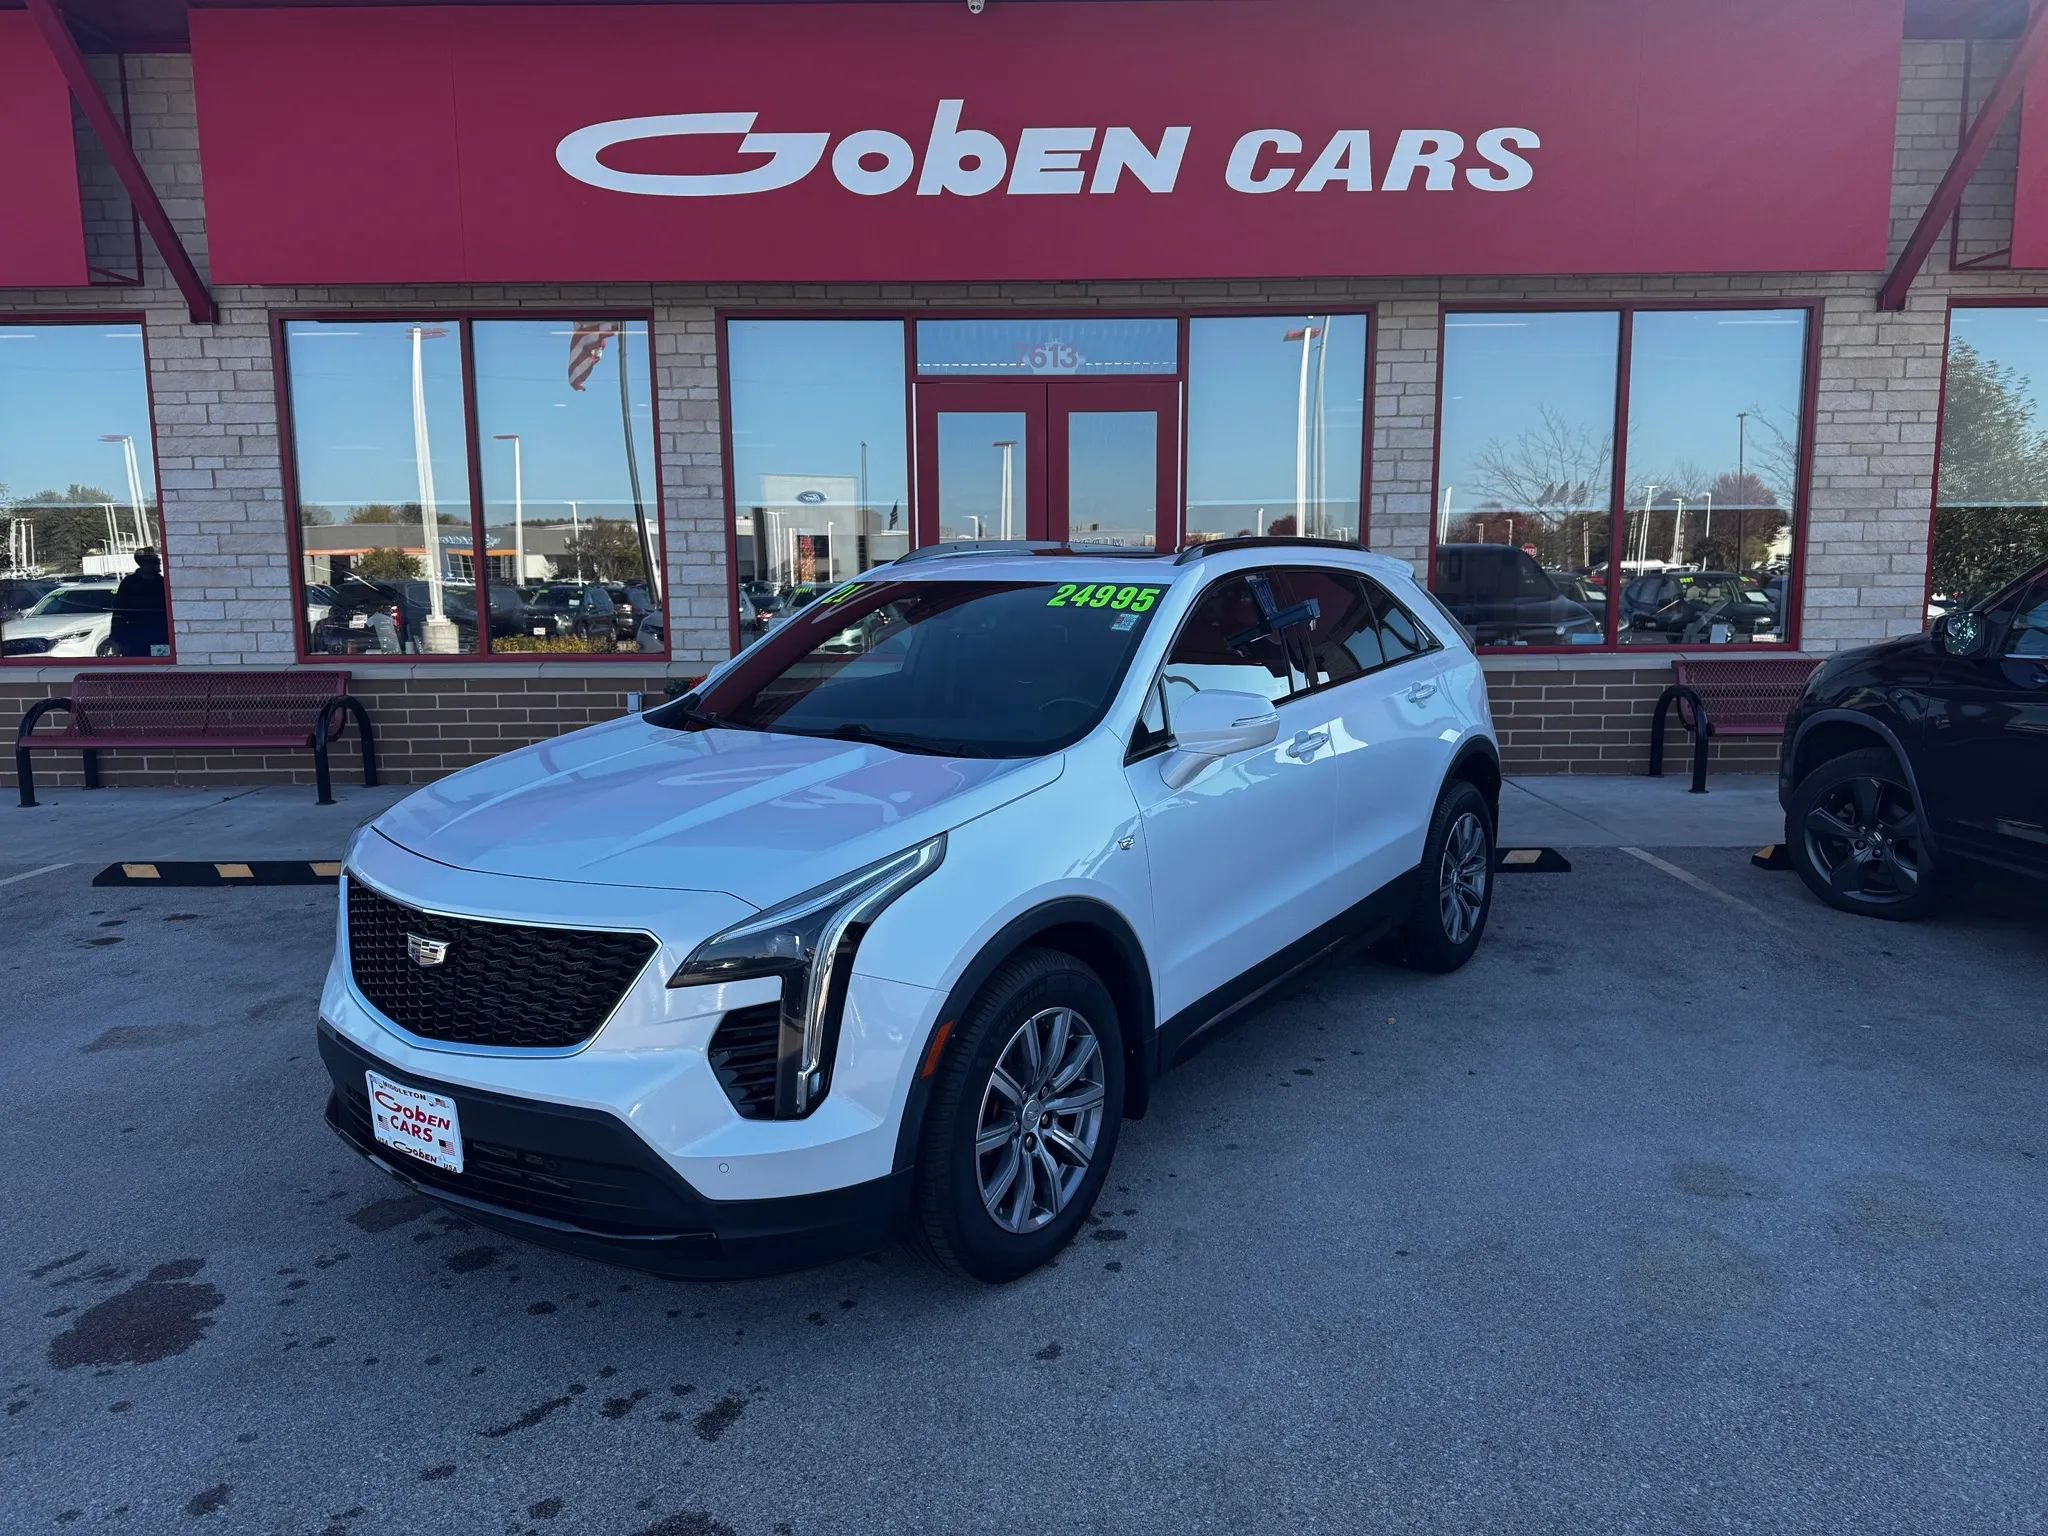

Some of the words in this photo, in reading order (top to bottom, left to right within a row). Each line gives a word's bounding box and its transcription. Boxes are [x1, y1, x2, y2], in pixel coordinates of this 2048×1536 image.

[1225, 127, 1541, 193] CARS
[1014, 343, 1078, 369] 7613
[1046, 584, 1161, 612] 24995
[382, 1080, 427, 1101] MIDDLETON
[390, 1115, 433, 1143] CARS
[443, 1162, 458, 1174] USA
